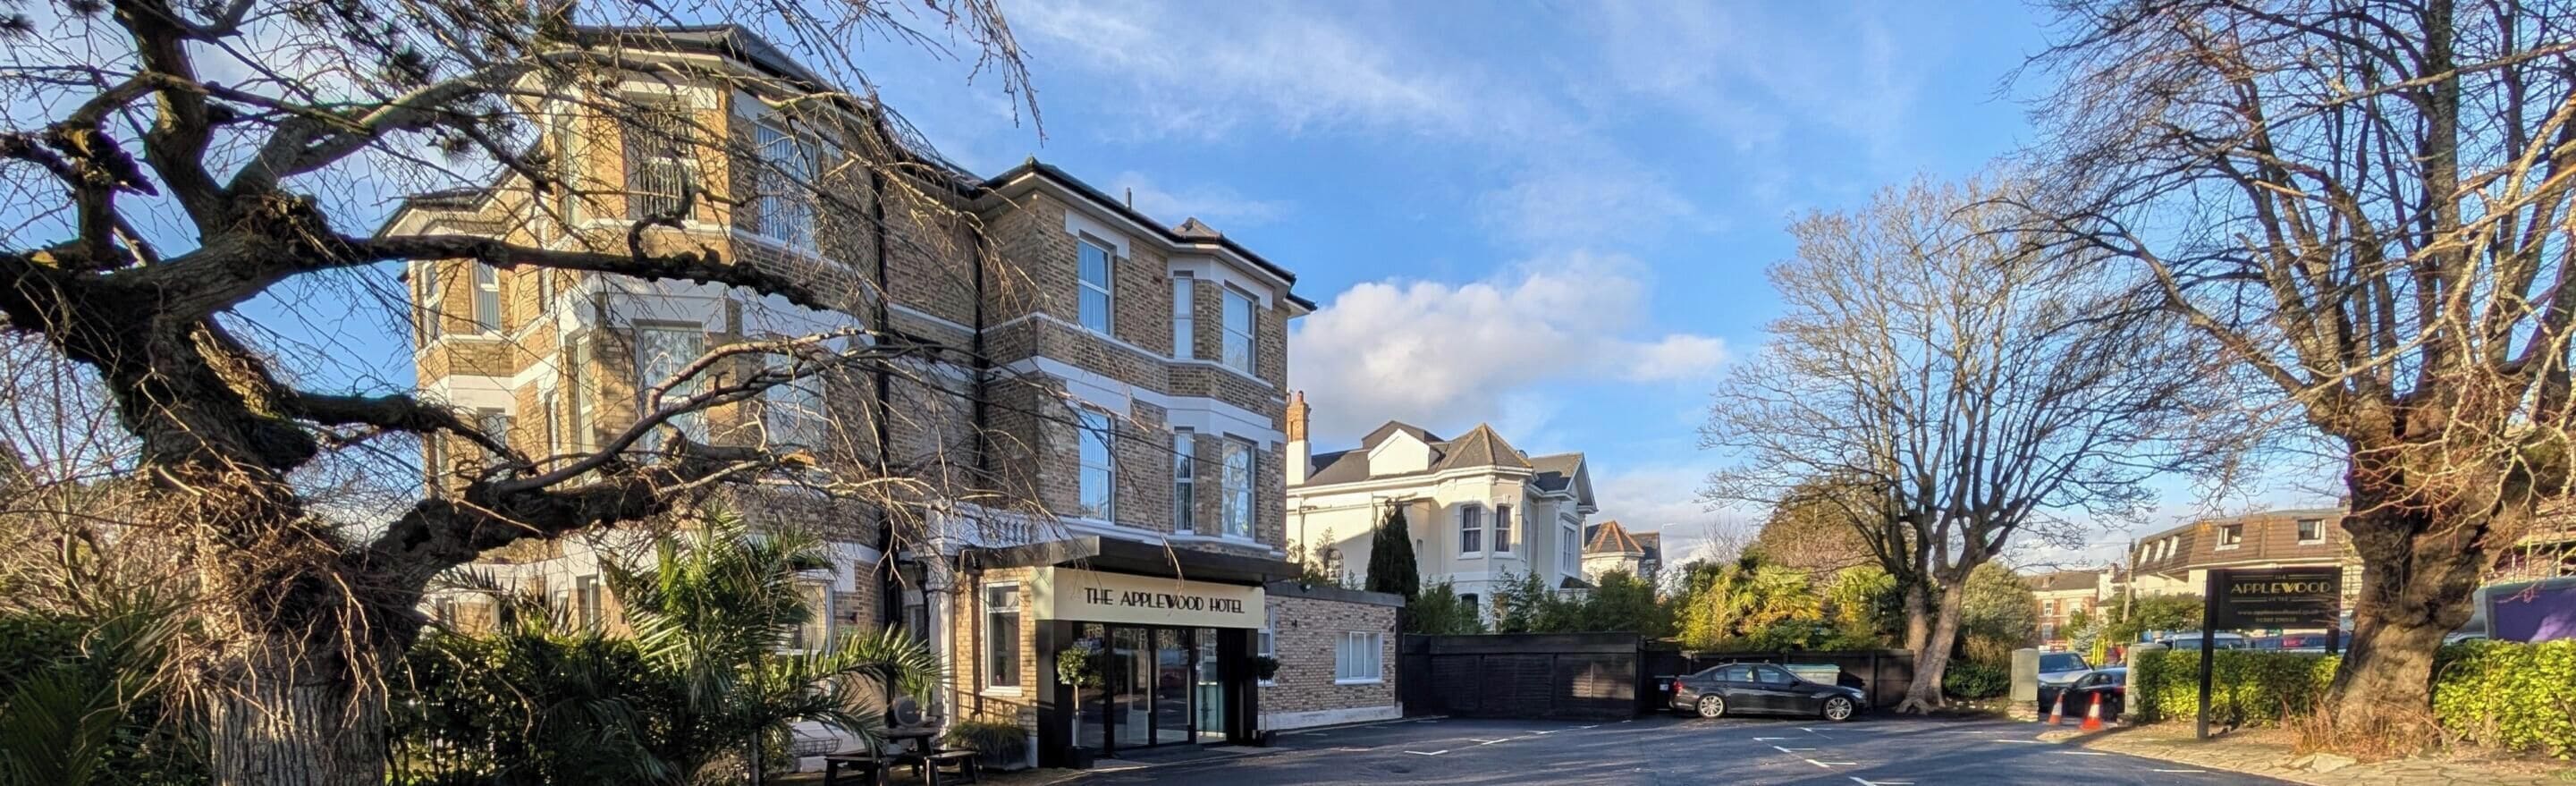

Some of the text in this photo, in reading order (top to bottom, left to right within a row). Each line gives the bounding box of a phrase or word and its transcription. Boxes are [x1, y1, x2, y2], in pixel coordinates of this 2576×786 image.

[2230, 581, 2332, 595] APPLEWOOD
[1084, 587, 1246, 614] THE APPLEWOOD HOTEL
